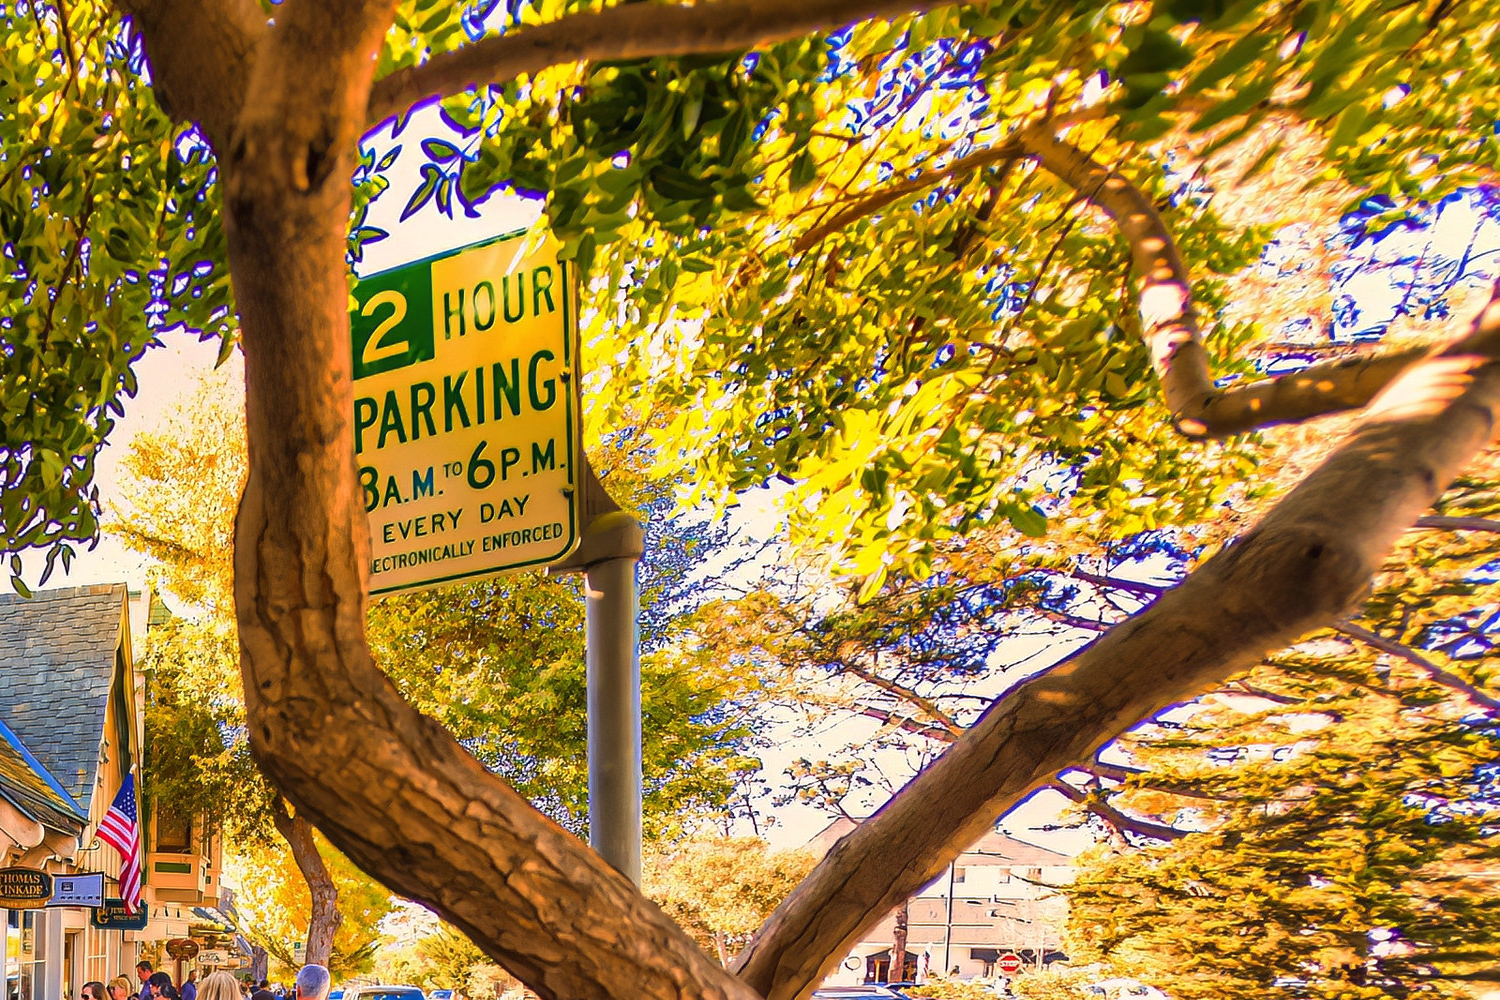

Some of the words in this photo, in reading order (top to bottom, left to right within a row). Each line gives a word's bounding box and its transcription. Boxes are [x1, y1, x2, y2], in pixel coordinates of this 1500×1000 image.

[361, 290, 409, 365] 2
[444, 266, 555, 340] HOUR
[354, 350, 556, 454] PARKING
[443, 461, 463, 478] TO
[383, 508, 463, 544] EVERY
[480, 494, 530, 524] DAY
[372, 540, 475, 574] ECTRONICALLY
[482, 522, 563, 552] ENFORCED
